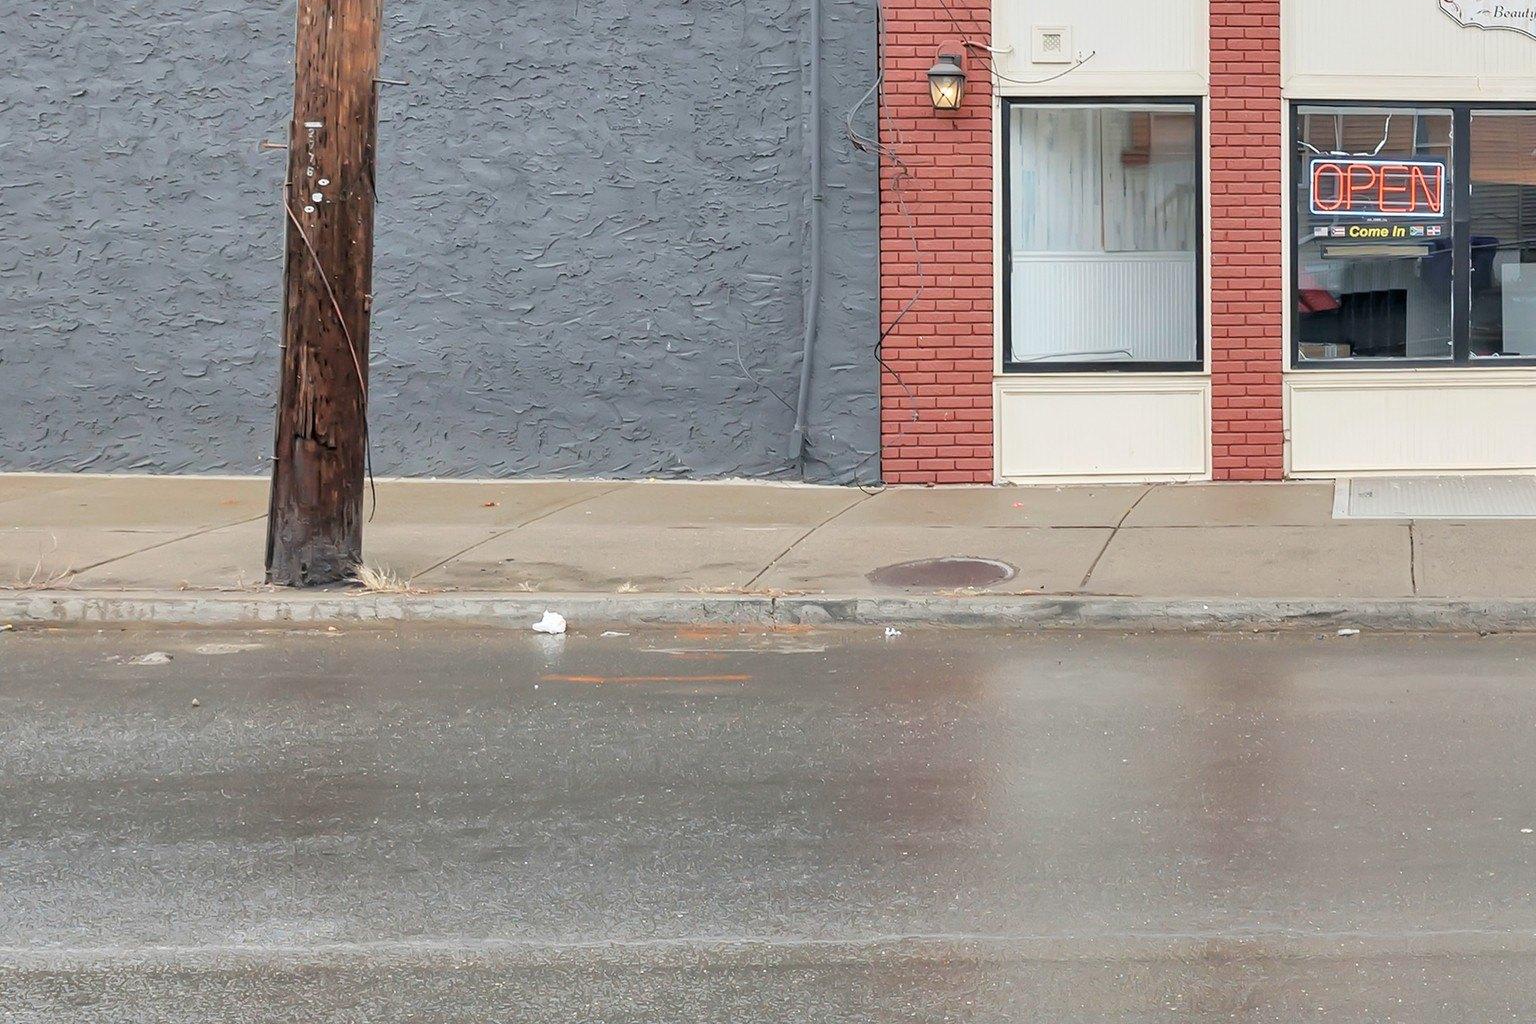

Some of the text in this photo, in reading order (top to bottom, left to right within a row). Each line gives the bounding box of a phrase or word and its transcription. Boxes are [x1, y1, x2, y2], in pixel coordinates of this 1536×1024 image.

[1314, 163, 1441, 213] OPEN
[1349, 225, 1406, 238] Come In
